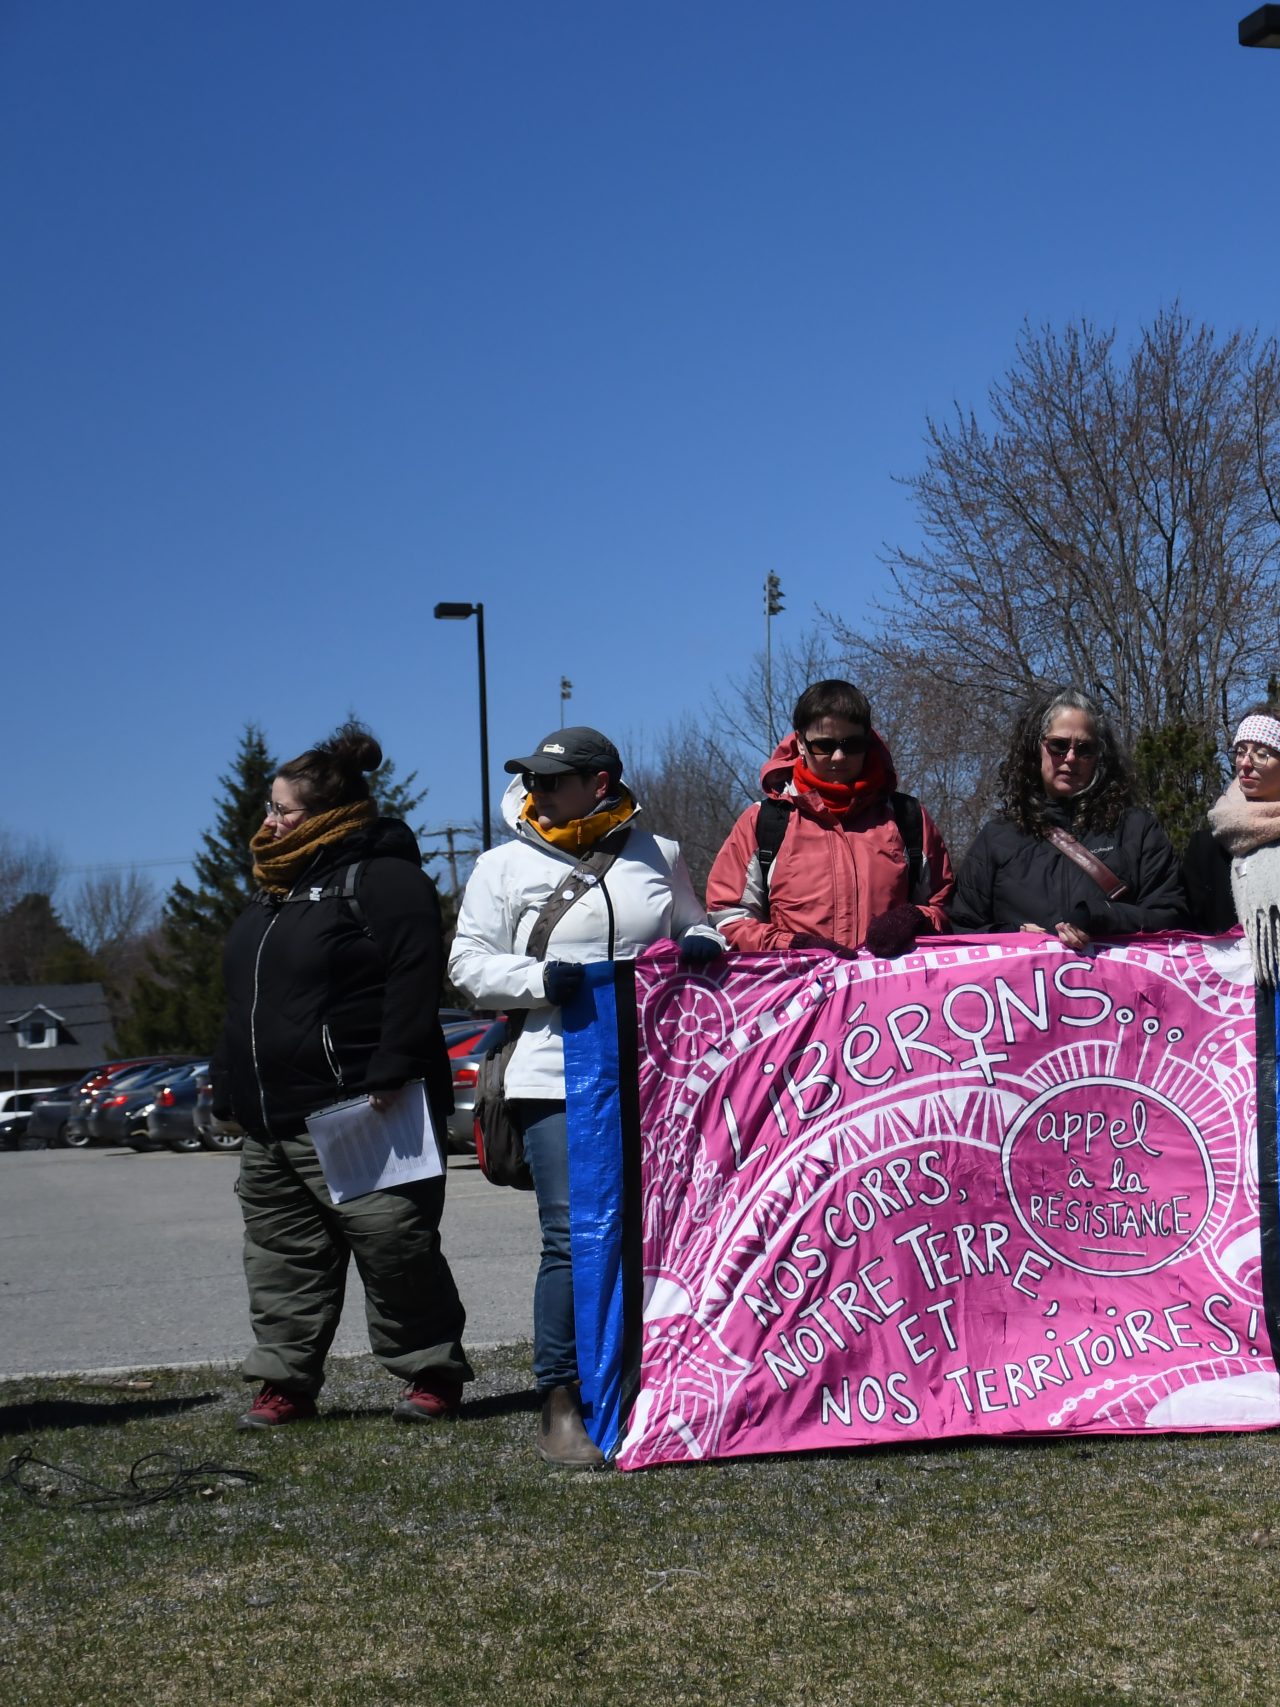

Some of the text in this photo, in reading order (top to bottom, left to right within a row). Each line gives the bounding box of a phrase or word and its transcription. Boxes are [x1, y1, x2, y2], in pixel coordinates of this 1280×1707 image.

[1036, 1099, 1163, 1158] appel
[1067, 1157, 1150, 1194] à la
[742, 1151, 967, 1328] NOS CORPS,
[763, 1256, 907, 1392] NOTRE
[897, 1298, 959, 1365] ET
[821, 1371, 920, 1426] NOS
